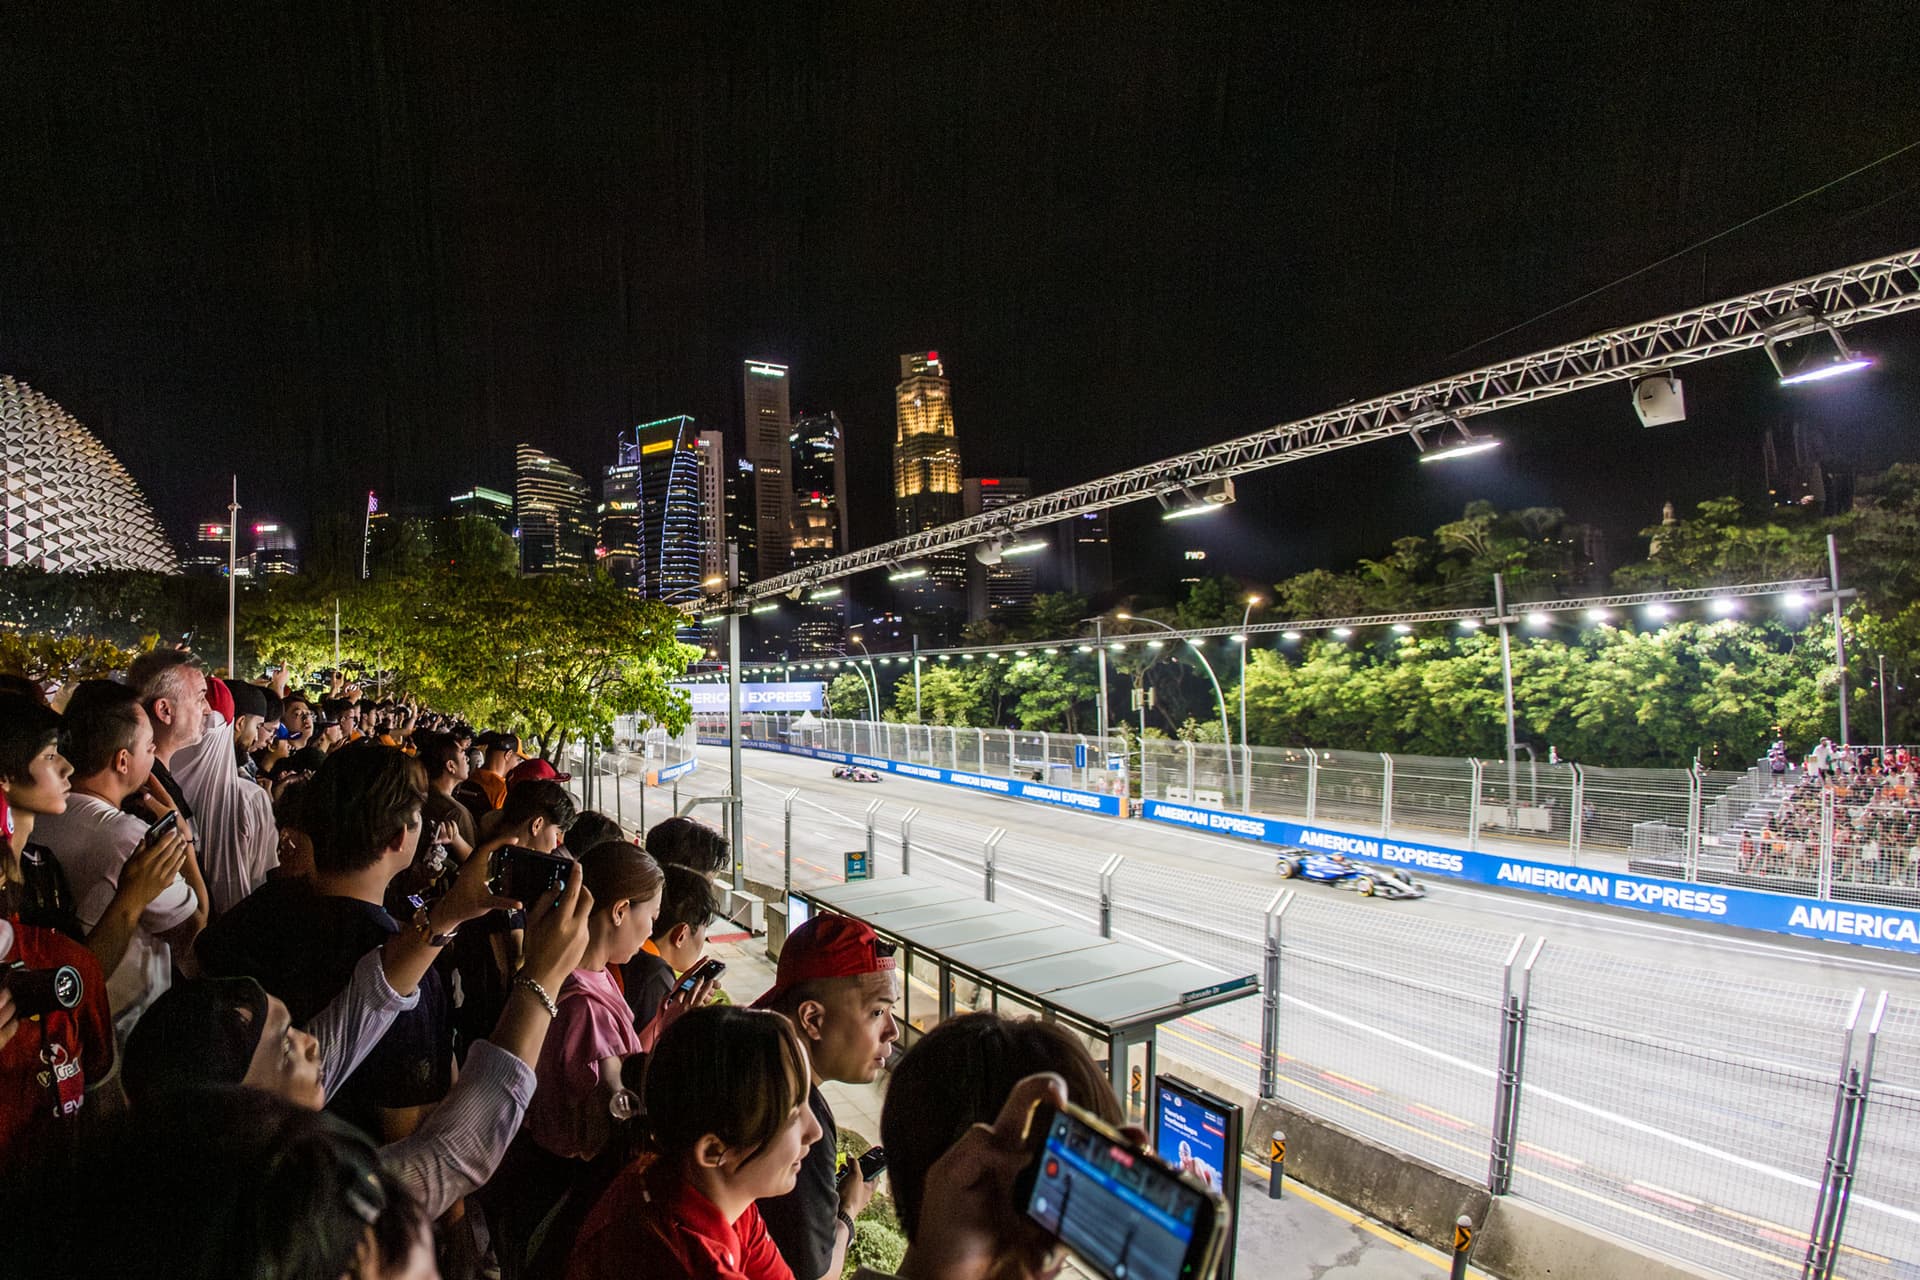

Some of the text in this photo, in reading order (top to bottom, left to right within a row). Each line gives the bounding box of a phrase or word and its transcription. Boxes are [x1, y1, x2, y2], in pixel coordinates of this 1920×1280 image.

[1185, 551, 1206, 560] FWD
[748, 691, 812, 703] EXPRESS
[951, 772, 1009, 792] AMERICAN EXPRESS
[1022, 785, 1101, 808] AMERICAN EXPRESS
[1153, 804, 1265, 836] AMERICAN EXPRESS
[1299, 830, 1464, 872] AMERICAN EXPRESS
[1496, 862, 1728, 916] AMERICAN EXPRESS
[1788, 904, 1920, 944] AMERICA
